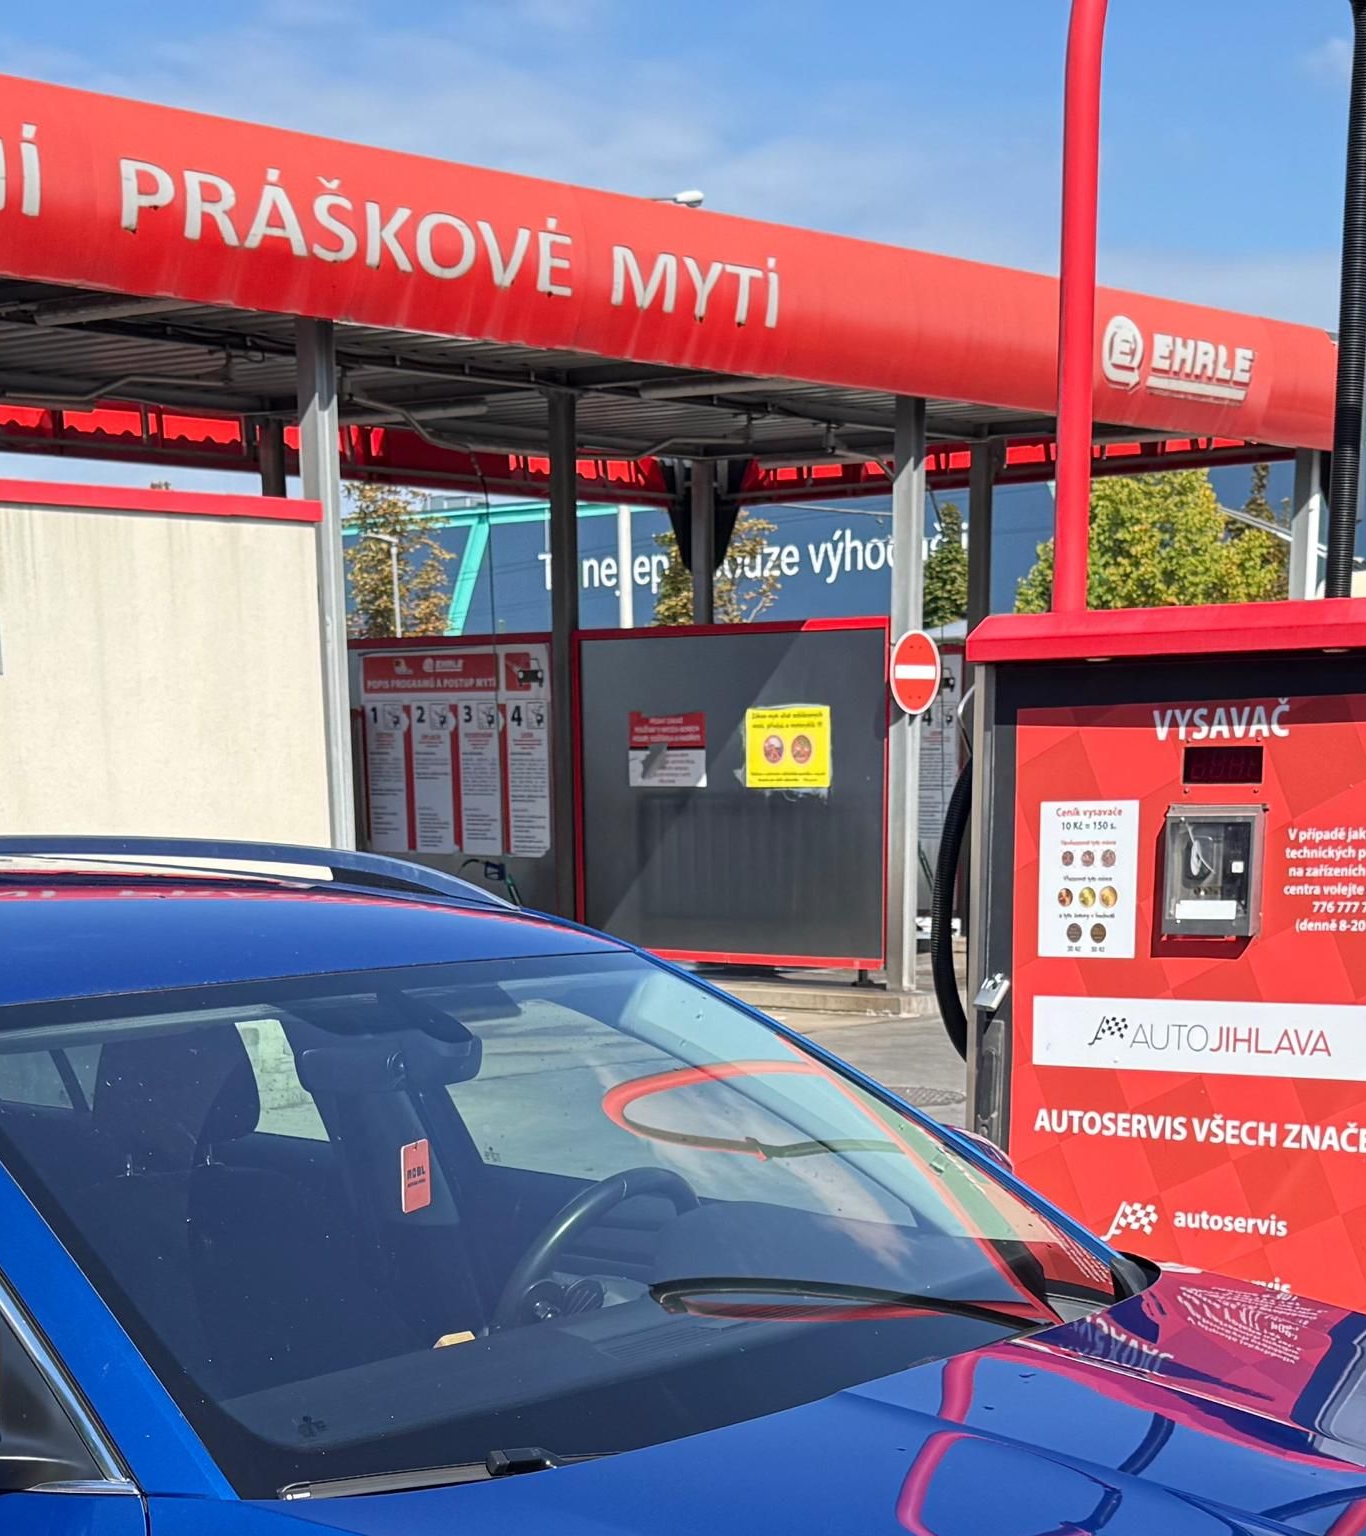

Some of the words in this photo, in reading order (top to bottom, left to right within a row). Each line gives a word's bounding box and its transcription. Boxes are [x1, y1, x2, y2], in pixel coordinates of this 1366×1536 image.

[118, 157, 573, 298] PRÁŠKOVÉ
[611, 245, 779, 330] MYTÍ
[1150, 332, 1256, 385] EHRLE
[371, 707, 378, 723] 1
[416, 706, 425, 723] 2
[463, 705, 473, 723] 3
[511, 705, 522, 726] 4
[1153, 698, 1290, 741] VYSAVAČ
[1056, 807, 1080, 818] Ceník
[1083, 808, 1122, 820] vysavače
[1061, 822, 1072, 831] 10
[1073, 821, 1083, 831] Kč
[1093, 821, 1108, 831] 150
[1288, 828, 1298, 840] V
[1299, 828, 1346, 843] případě
[1285, 846, 1355, 861] technických
[1288, 866, 1304, 877] na
[1305, 864, 1366, 877] zařízeních
[1283, 884, 1321, 895] centra
[1323, 883, 1365, 897] volejte
[1312, 901, 1335, 913] 776
[1337, 901, 1360, 913] 777
[1295, 918, 1337, 933] (denně
[1339, 919, 1366, 932] 8-20
[1129, 1023, 1332, 1057] AUTOJIHLAVA
[1034, 1108, 1188, 1142] AUTOSERVIS
[1192, 1114, 1277, 1148] VŠECH
[1173, 1208, 1288, 1237] autoservis
